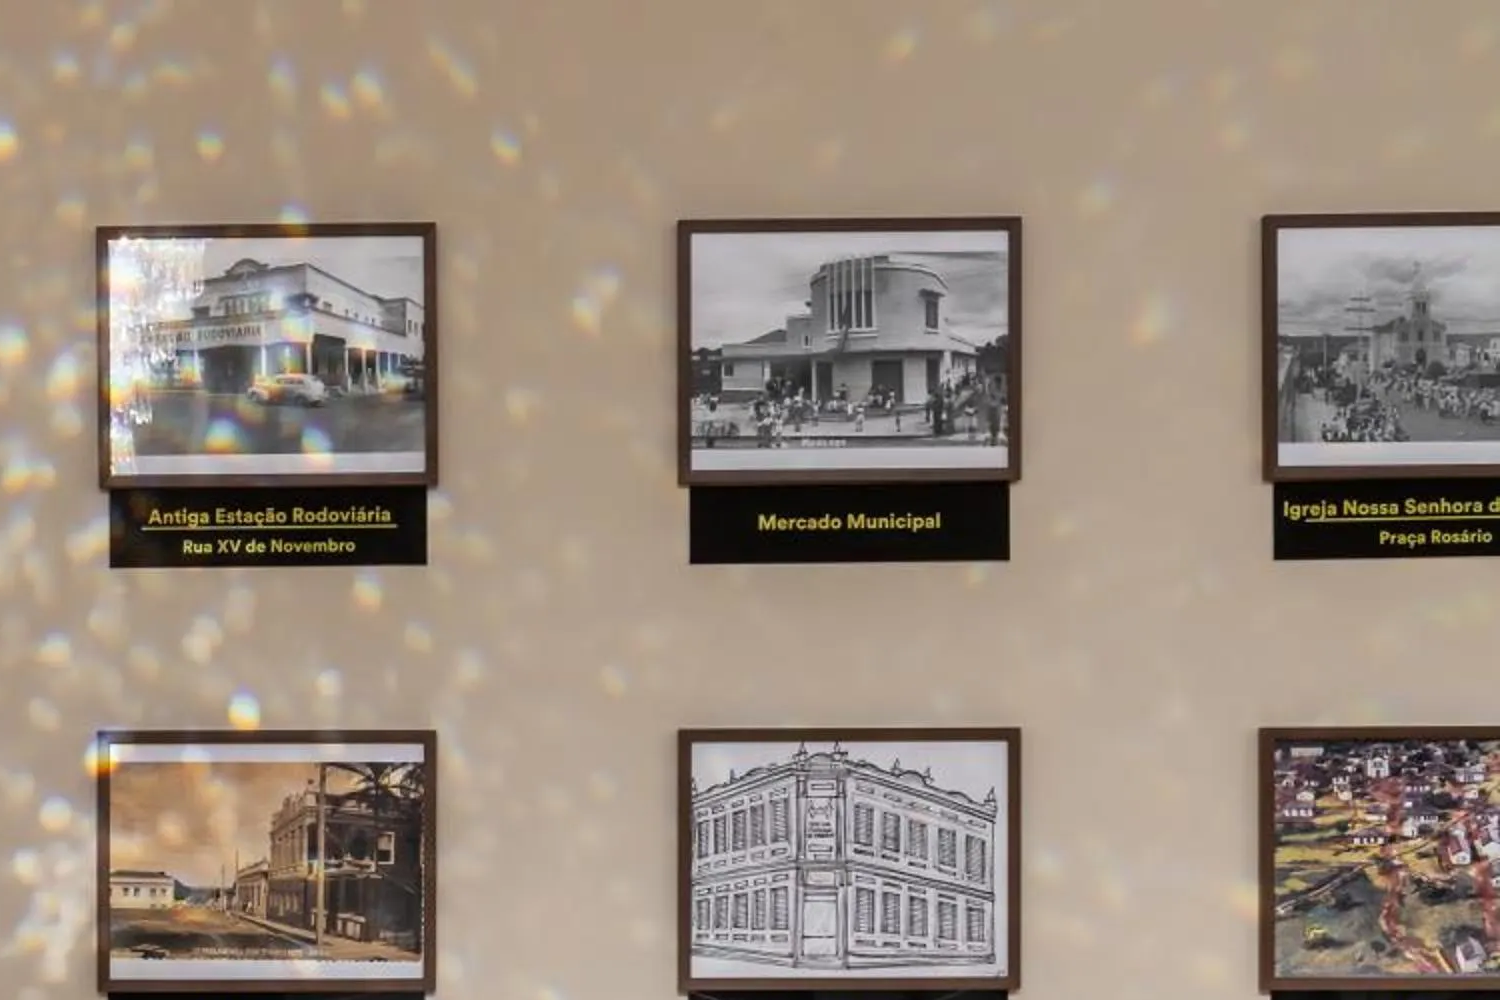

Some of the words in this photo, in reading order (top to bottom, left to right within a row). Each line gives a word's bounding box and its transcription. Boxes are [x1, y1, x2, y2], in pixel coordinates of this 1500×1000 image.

[148, 508, 209, 528] Antiga
[215, 507, 287, 527] Estação
[292, 505, 391, 524] Rodoviária
[1284, 501, 1337, 520] Igreja
[1343, 500, 1399, 515] Nossa
[1404, 498, 1483, 514] Senhora
[758, 513, 842, 531] Mercado
[847, 512, 941, 533] Municipal
[183, 540, 213, 555] Rua
[217, 539, 241, 554] XV
[245, 538, 266, 553] de
[271, 537, 357, 553] Novembro
[1379, 531, 1426, 549] Praça
[1431, 529, 1493, 544] Rosário
